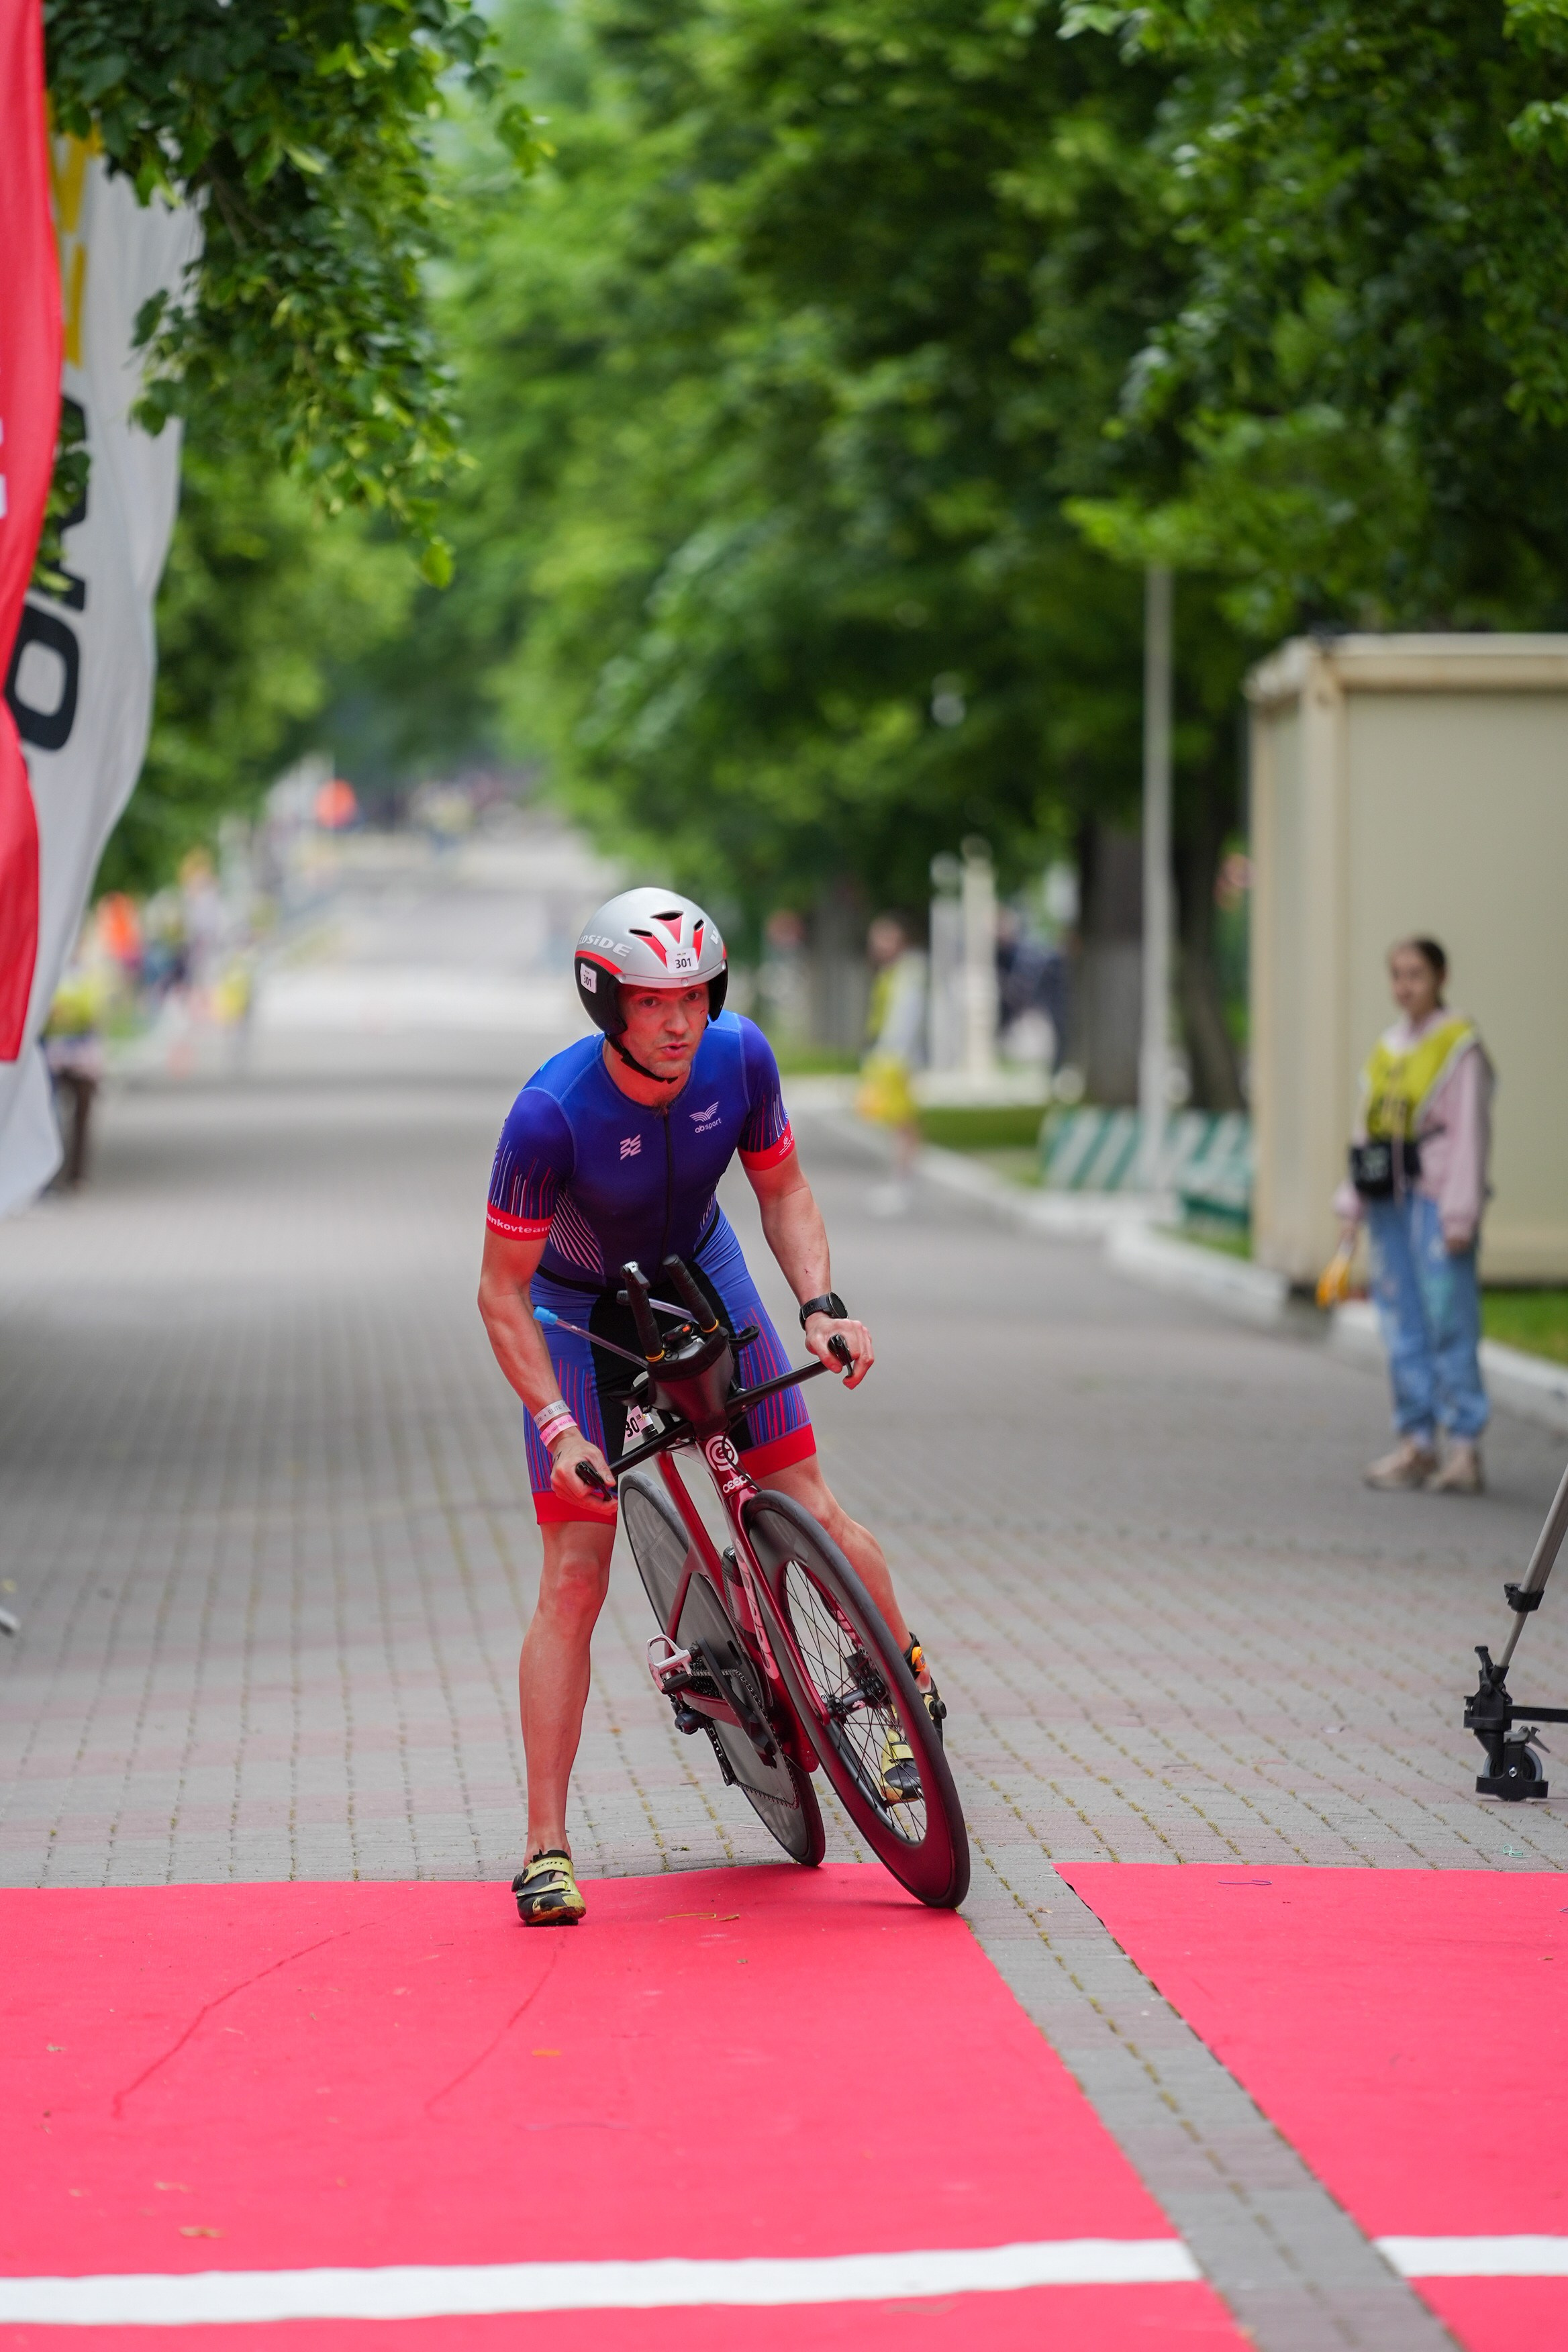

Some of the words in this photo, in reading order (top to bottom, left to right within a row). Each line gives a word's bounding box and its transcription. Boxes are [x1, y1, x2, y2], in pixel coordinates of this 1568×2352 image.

[675, 958, 691, 969] 301
[583, 975, 591, 987] 301
[548, 1405, 562, 1414] ELITE
[535, 1861, 563, 1870] SCOTT
